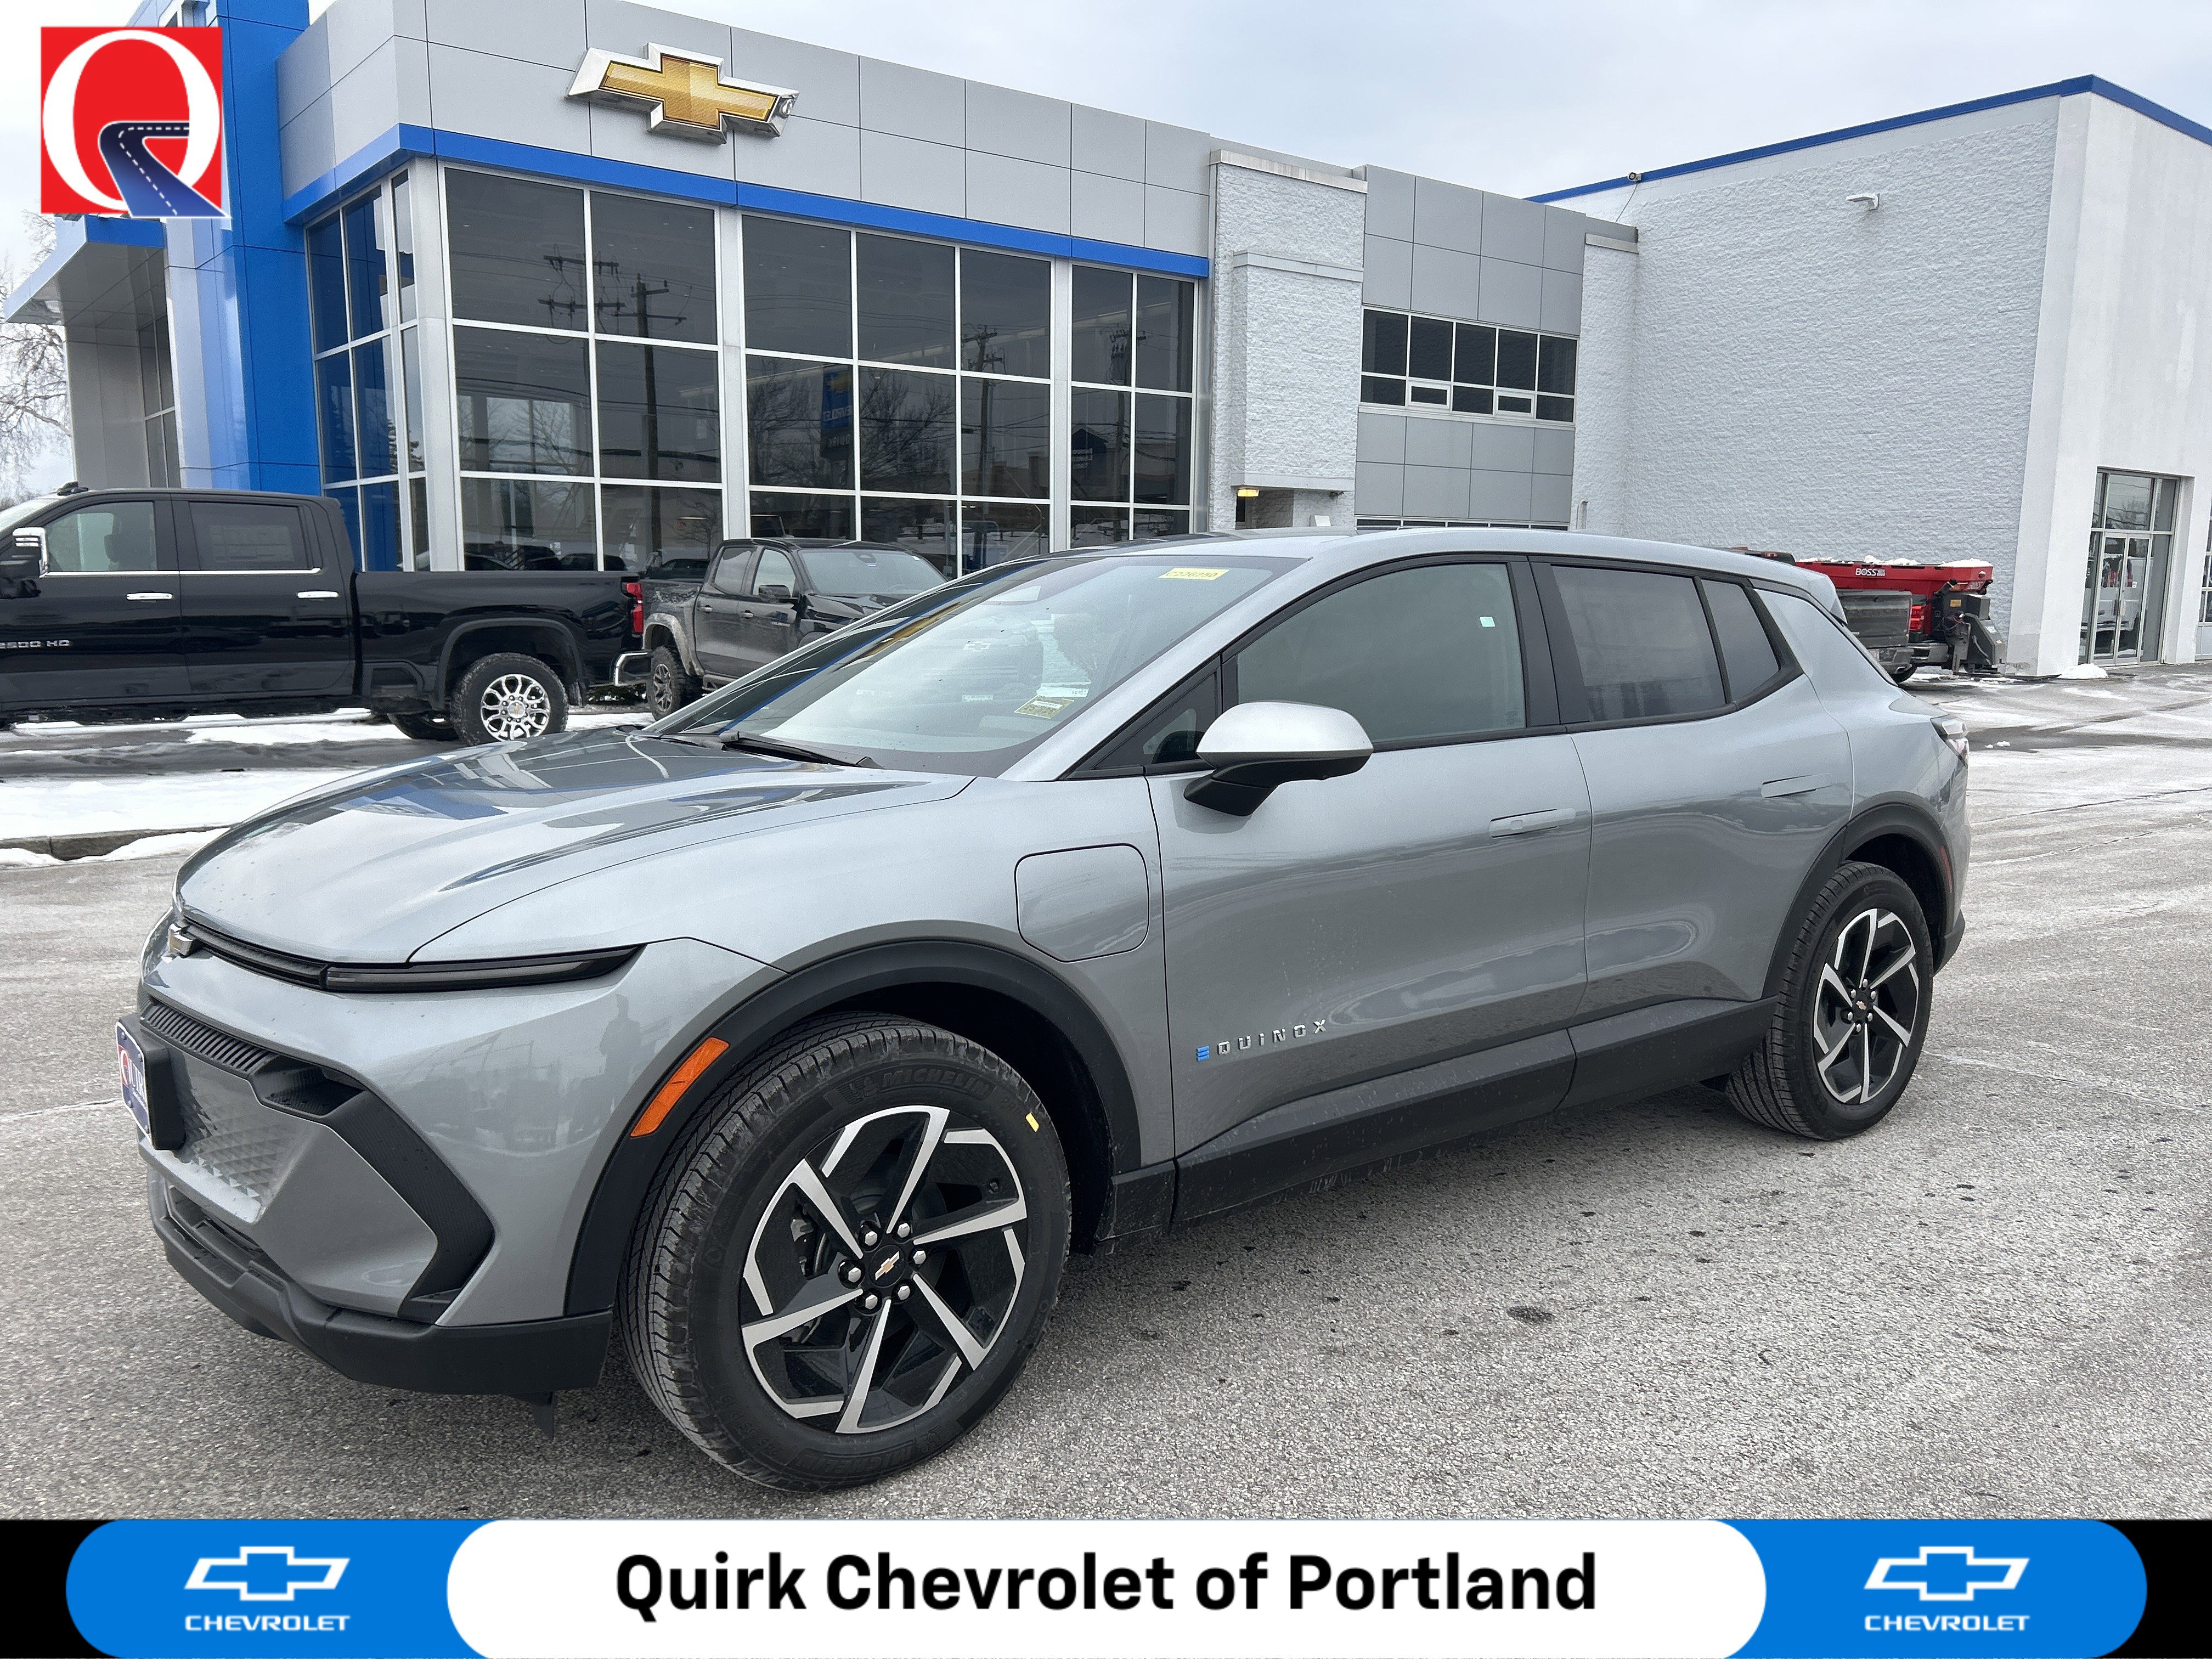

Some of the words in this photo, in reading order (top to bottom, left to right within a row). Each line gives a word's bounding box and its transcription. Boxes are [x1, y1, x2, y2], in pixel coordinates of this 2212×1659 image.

[1855, 568, 1877, 576] BOSS
[1196, 1019, 1327, 1062] EQUINOX
[882, 1068, 991, 1096] MICHELIN
